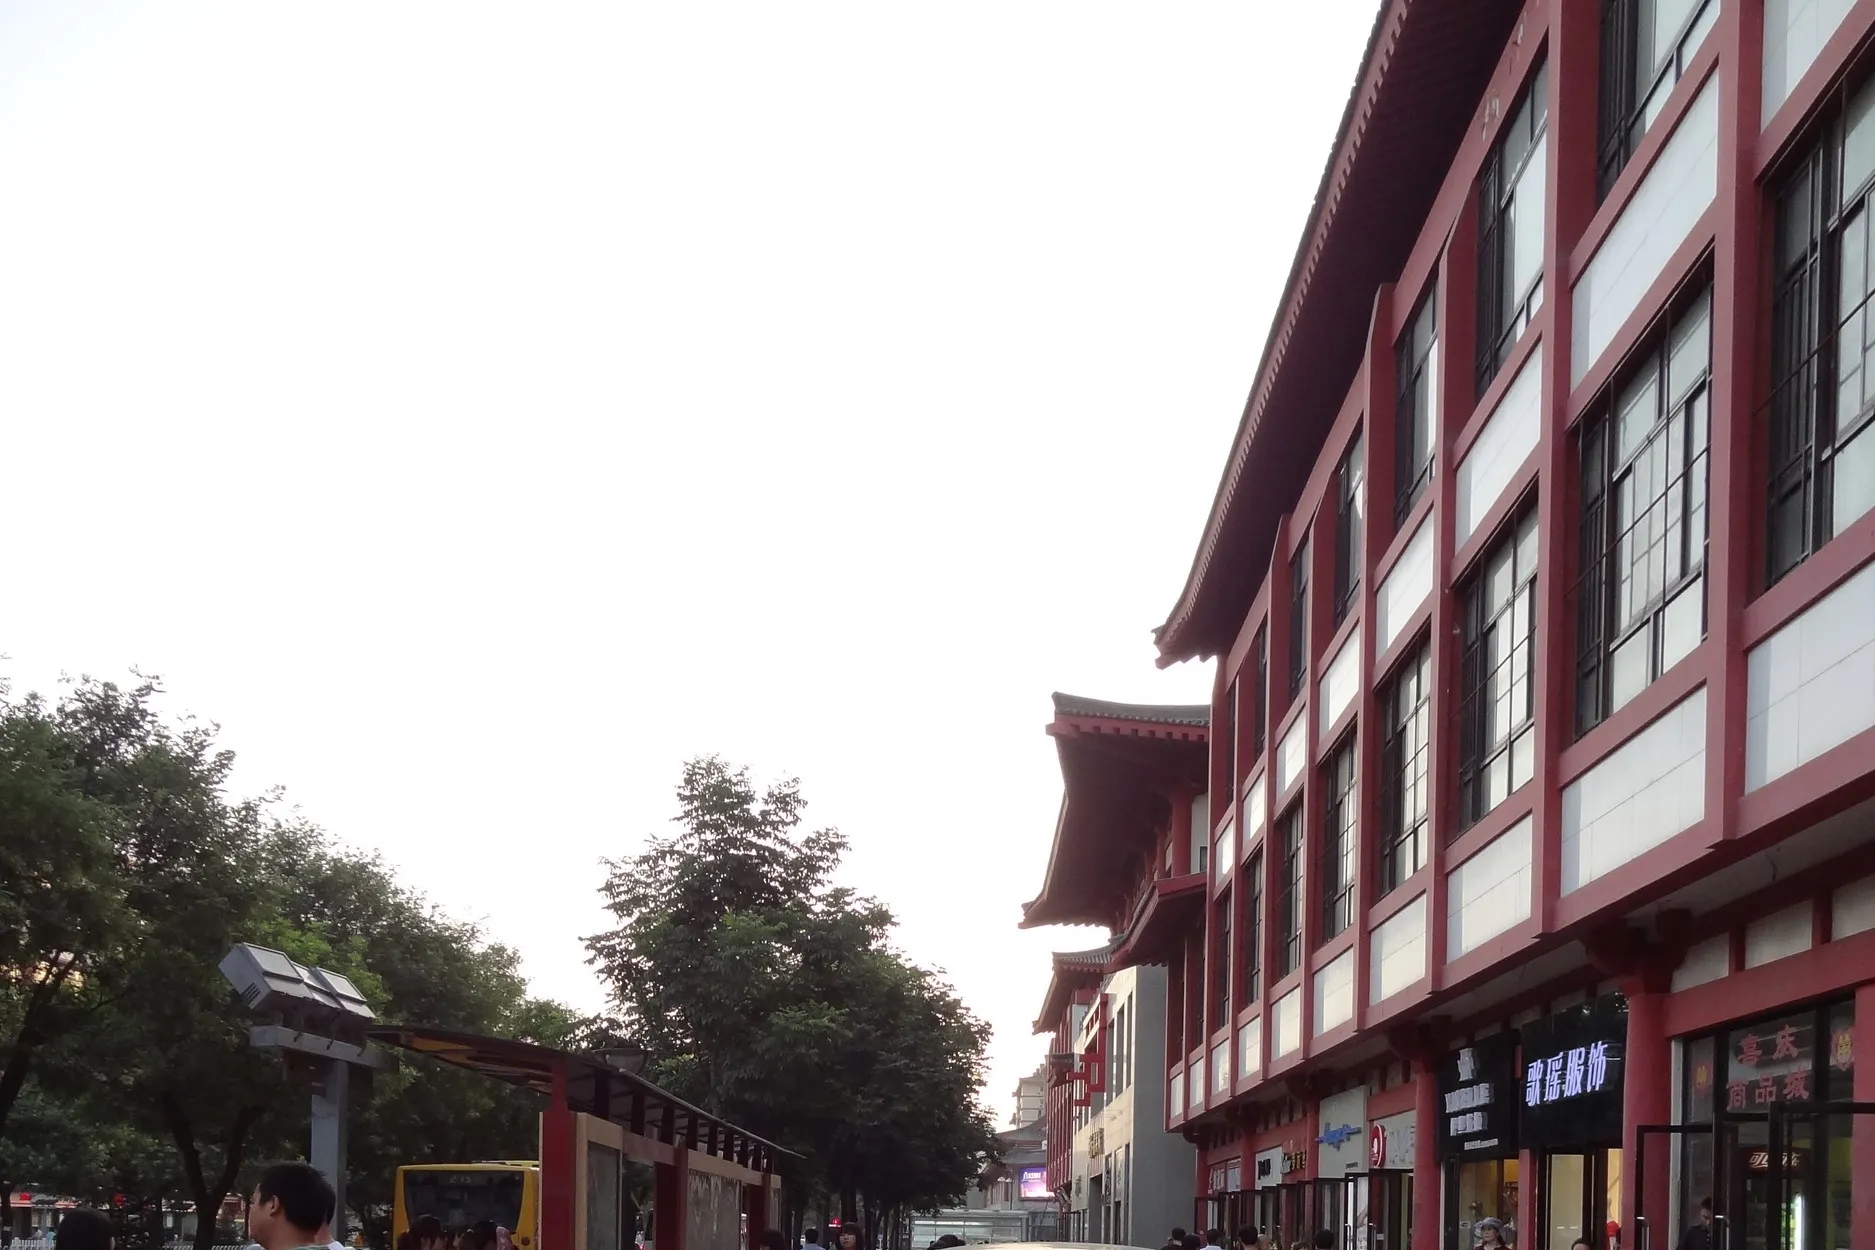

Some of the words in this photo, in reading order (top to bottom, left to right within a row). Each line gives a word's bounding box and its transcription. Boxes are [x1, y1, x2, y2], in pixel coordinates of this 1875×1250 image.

[1737, 1024, 1800, 1066] 喜庆
[1525, 1040, 1608, 1107] 歌瑶服饰
[1726, 1066, 1810, 1111] 商品城
